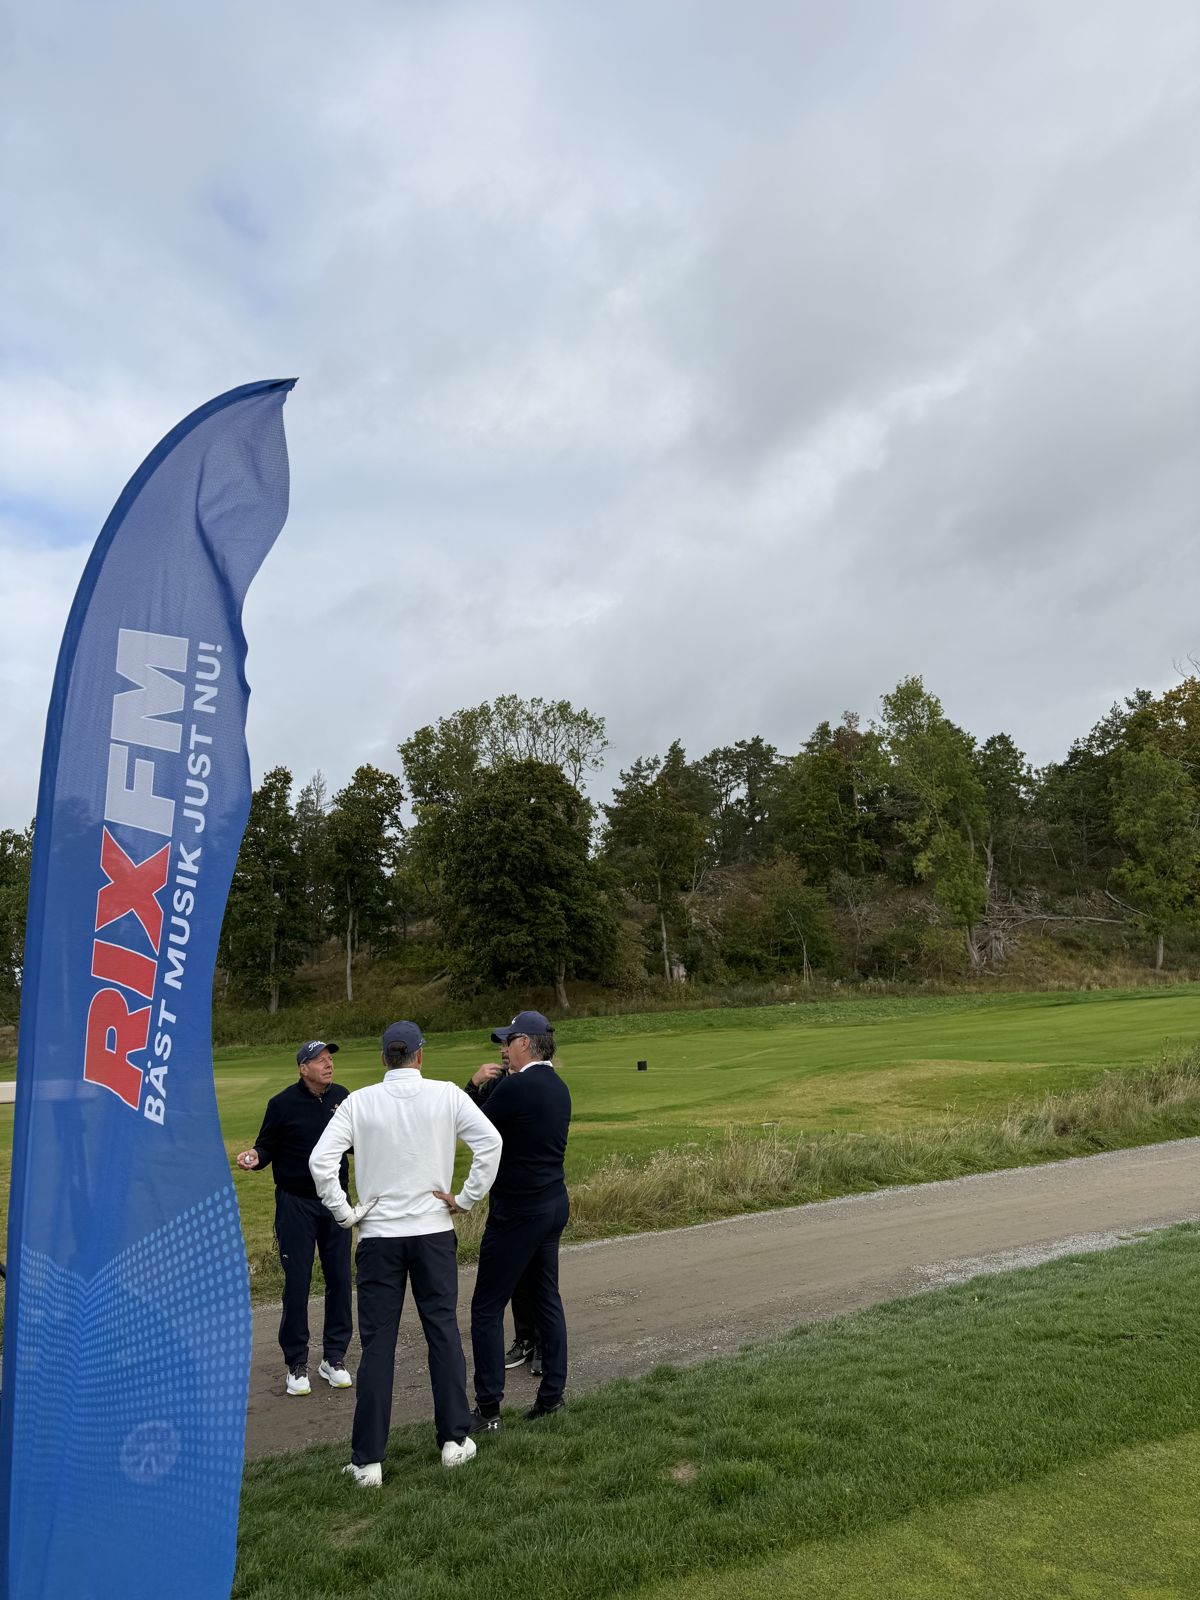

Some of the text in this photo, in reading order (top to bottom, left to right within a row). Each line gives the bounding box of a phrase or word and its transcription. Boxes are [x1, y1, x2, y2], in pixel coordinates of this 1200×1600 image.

[143, 641, 222, 1126] BÄST MUSIK JUST NU!
